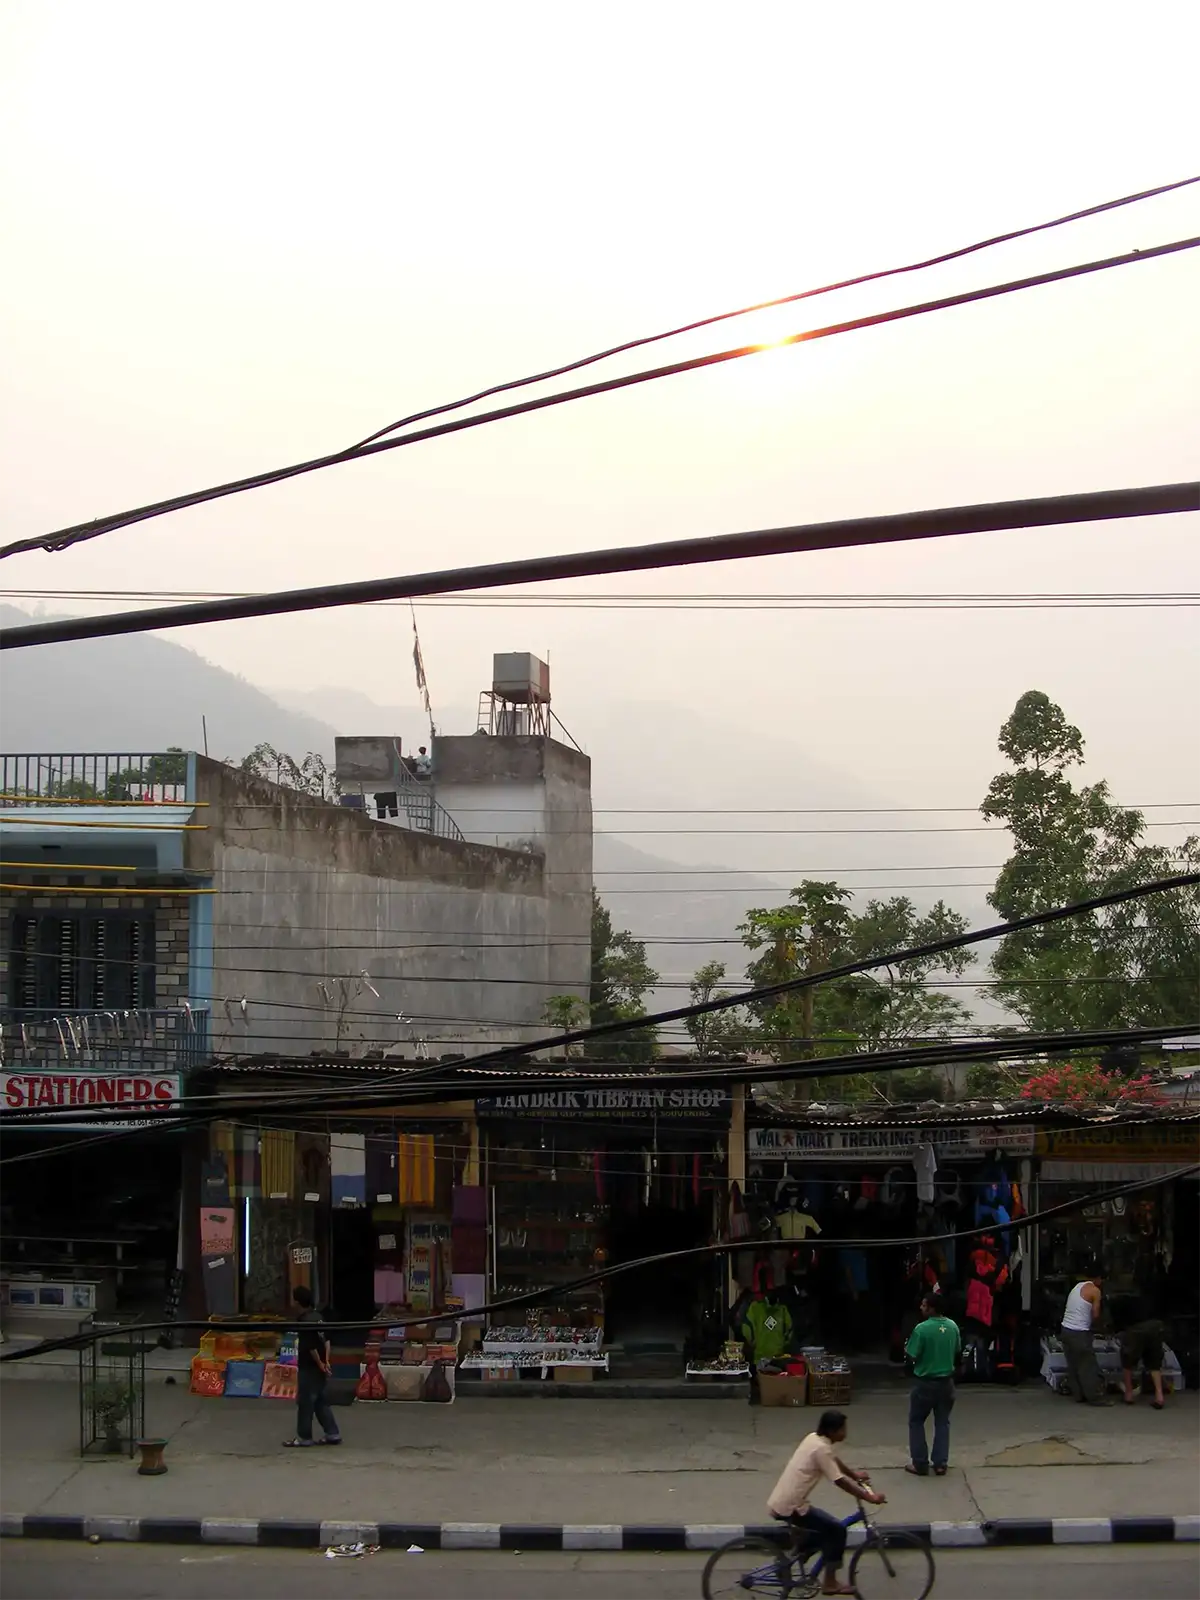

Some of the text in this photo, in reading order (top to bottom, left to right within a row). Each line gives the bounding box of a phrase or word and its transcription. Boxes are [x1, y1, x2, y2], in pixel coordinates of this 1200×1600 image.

[6, 1077, 174, 1111] STATIONERS
[584, 1089, 664, 1108] TIBETAN
[669, 1088, 726, 1108] SHOP
[756, 1131, 782, 1147] WAL
[796, 1131, 834, 1149] MART
[840, 1130, 915, 1148] TREKKING
[918, 1128, 970, 1147] STORE
